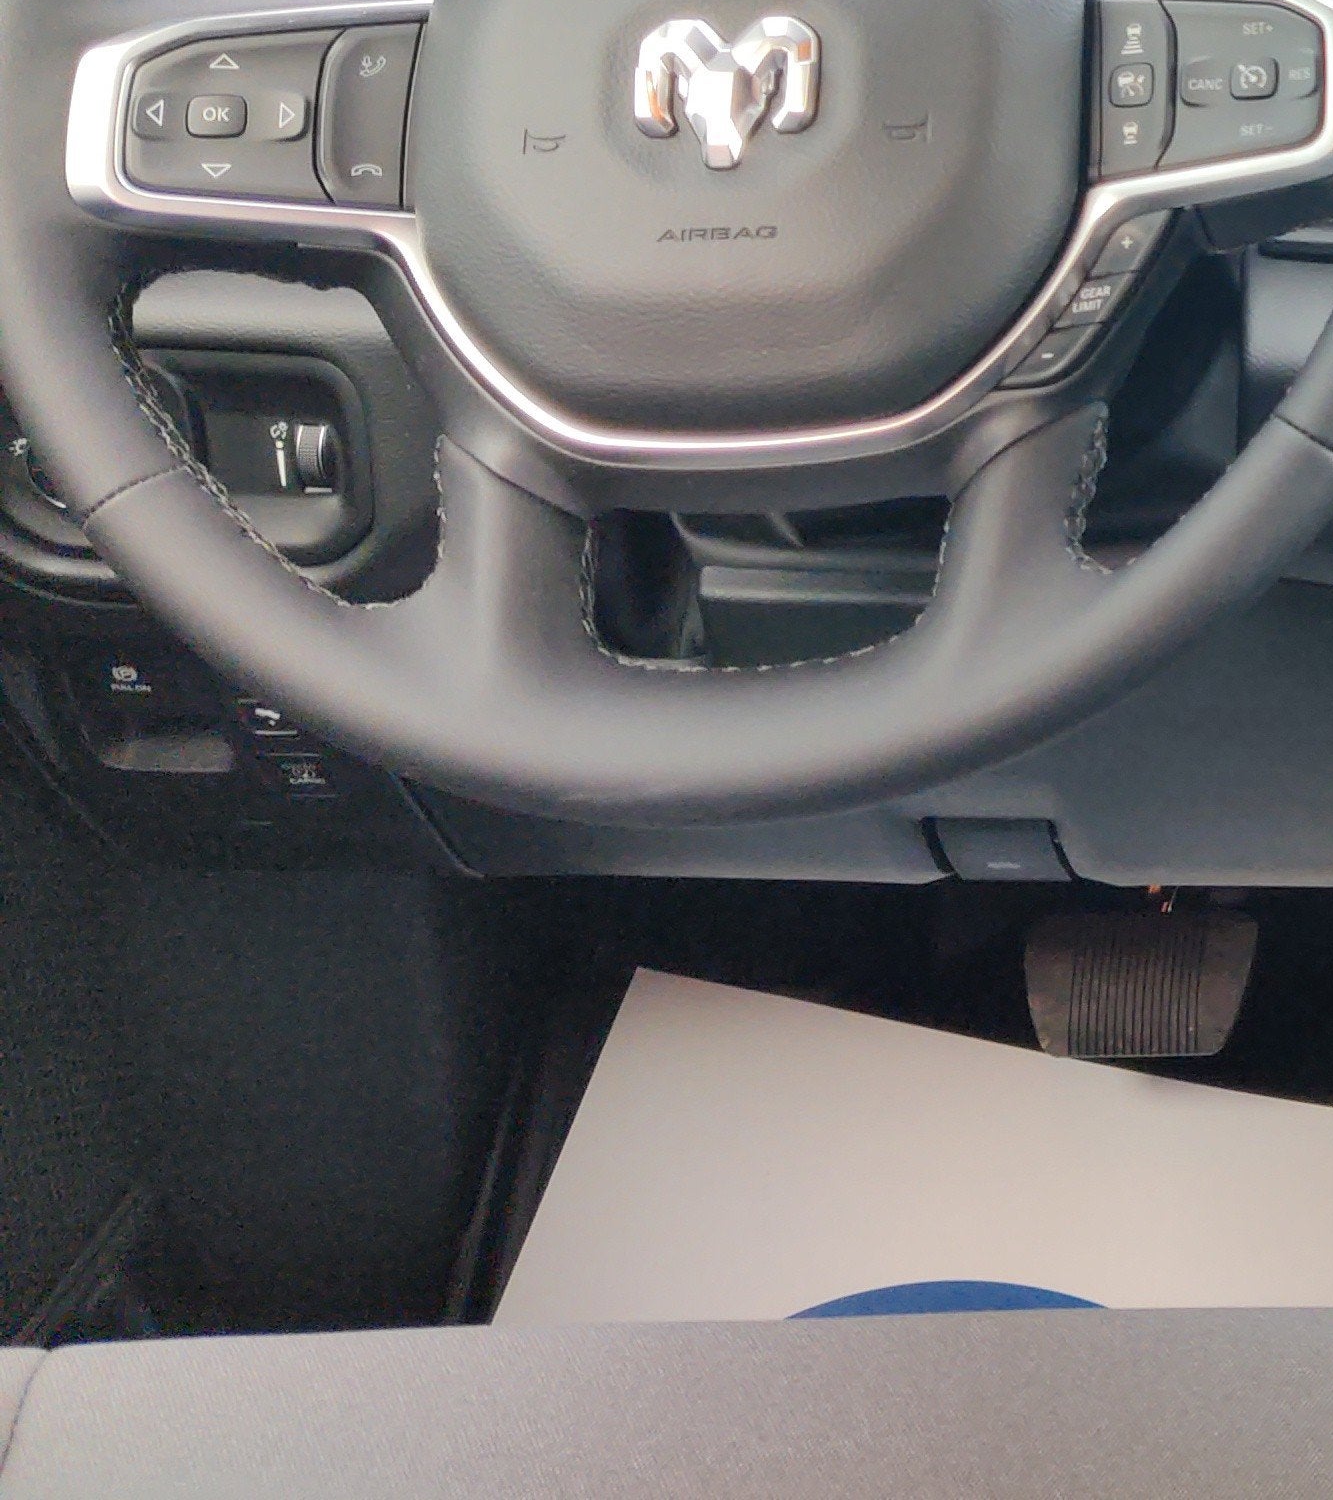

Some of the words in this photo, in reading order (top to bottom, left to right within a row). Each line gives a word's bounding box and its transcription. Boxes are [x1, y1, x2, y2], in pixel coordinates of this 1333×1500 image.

[1188, 77, 1224, 92] CANC
[202, 107, 231, 122] OK
[656, 225, 778, 243] AIRBAG
[1080, 286, 1112, 299] GEAR
